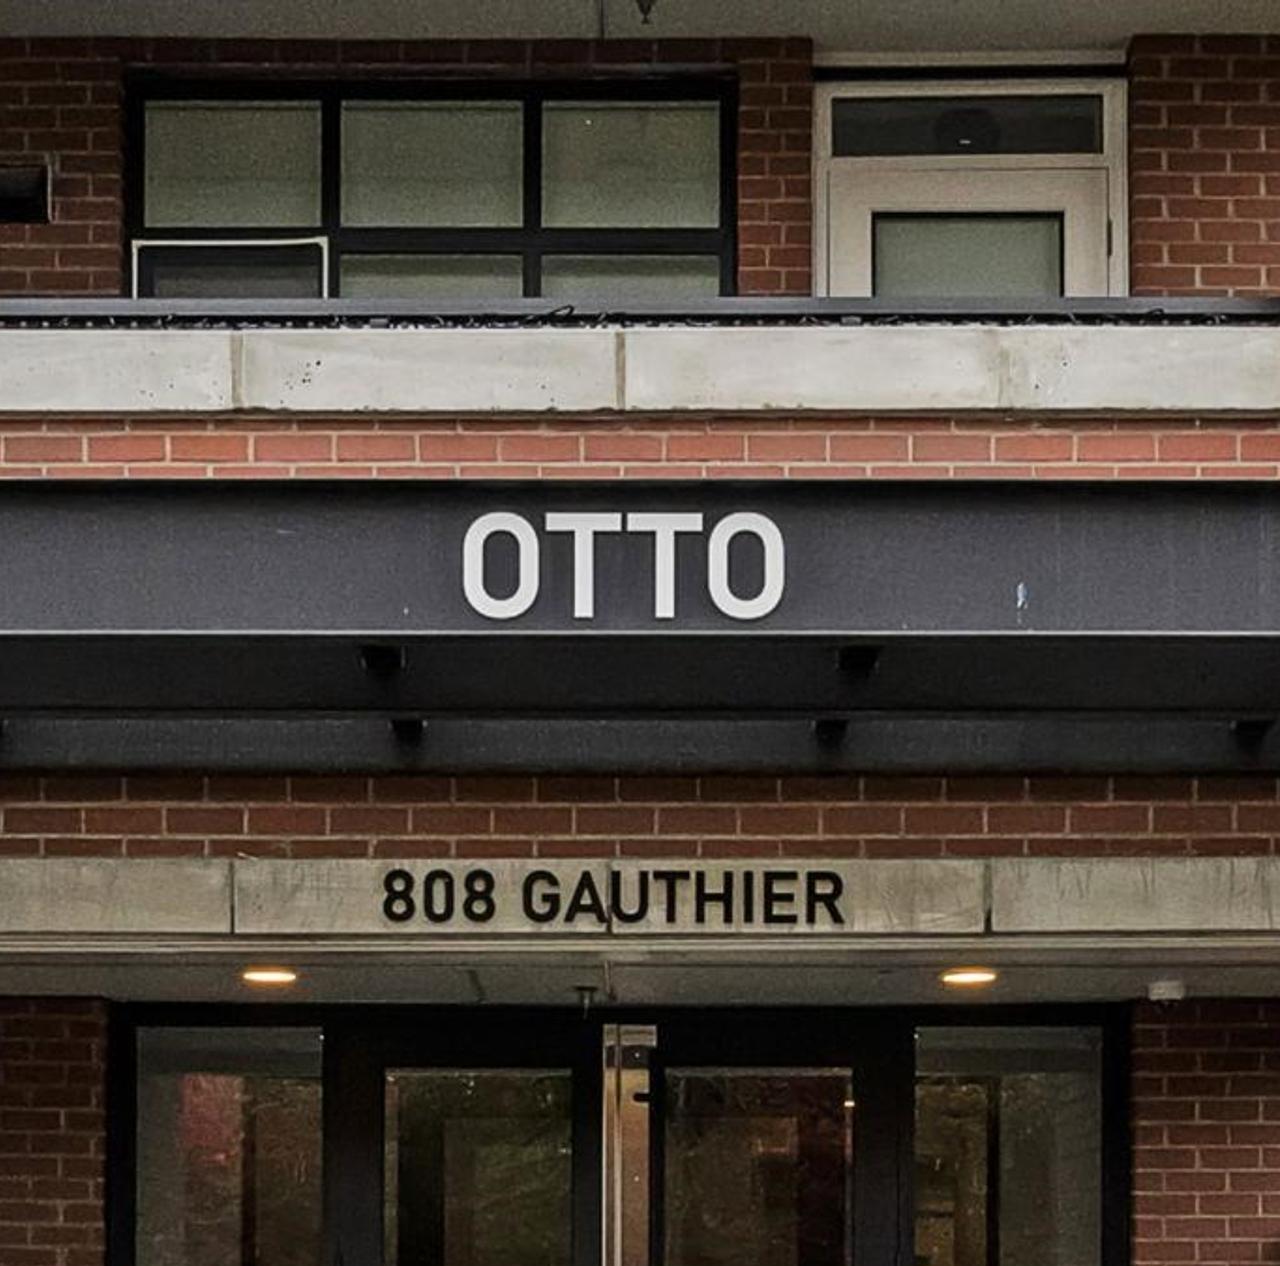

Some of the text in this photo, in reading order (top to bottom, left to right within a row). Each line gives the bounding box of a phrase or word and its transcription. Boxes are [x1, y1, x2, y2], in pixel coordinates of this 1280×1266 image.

[464, 511, 784, 619] OTTO
[382, 869, 845, 925] 808 GAUTHIER
